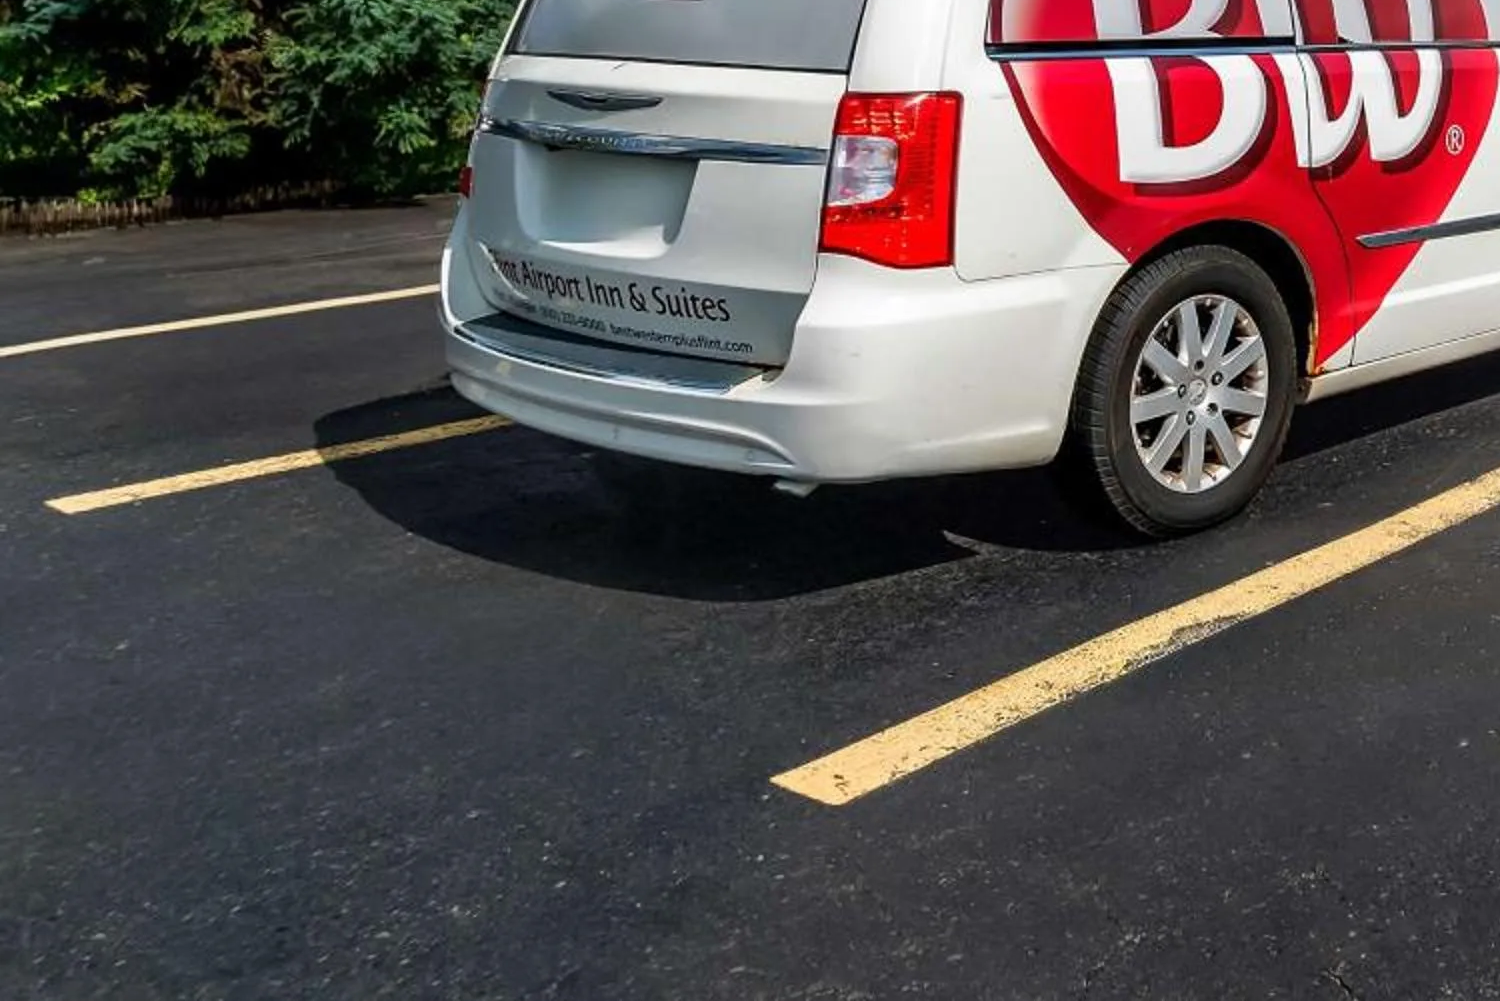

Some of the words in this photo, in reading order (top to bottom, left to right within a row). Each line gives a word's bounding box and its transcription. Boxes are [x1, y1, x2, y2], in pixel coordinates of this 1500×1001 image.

[521, 260, 585, 301] Airport
[586, 275, 625, 309] Inn
[628, 282, 650, 312] &
[652, 286, 731, 322] Suites
